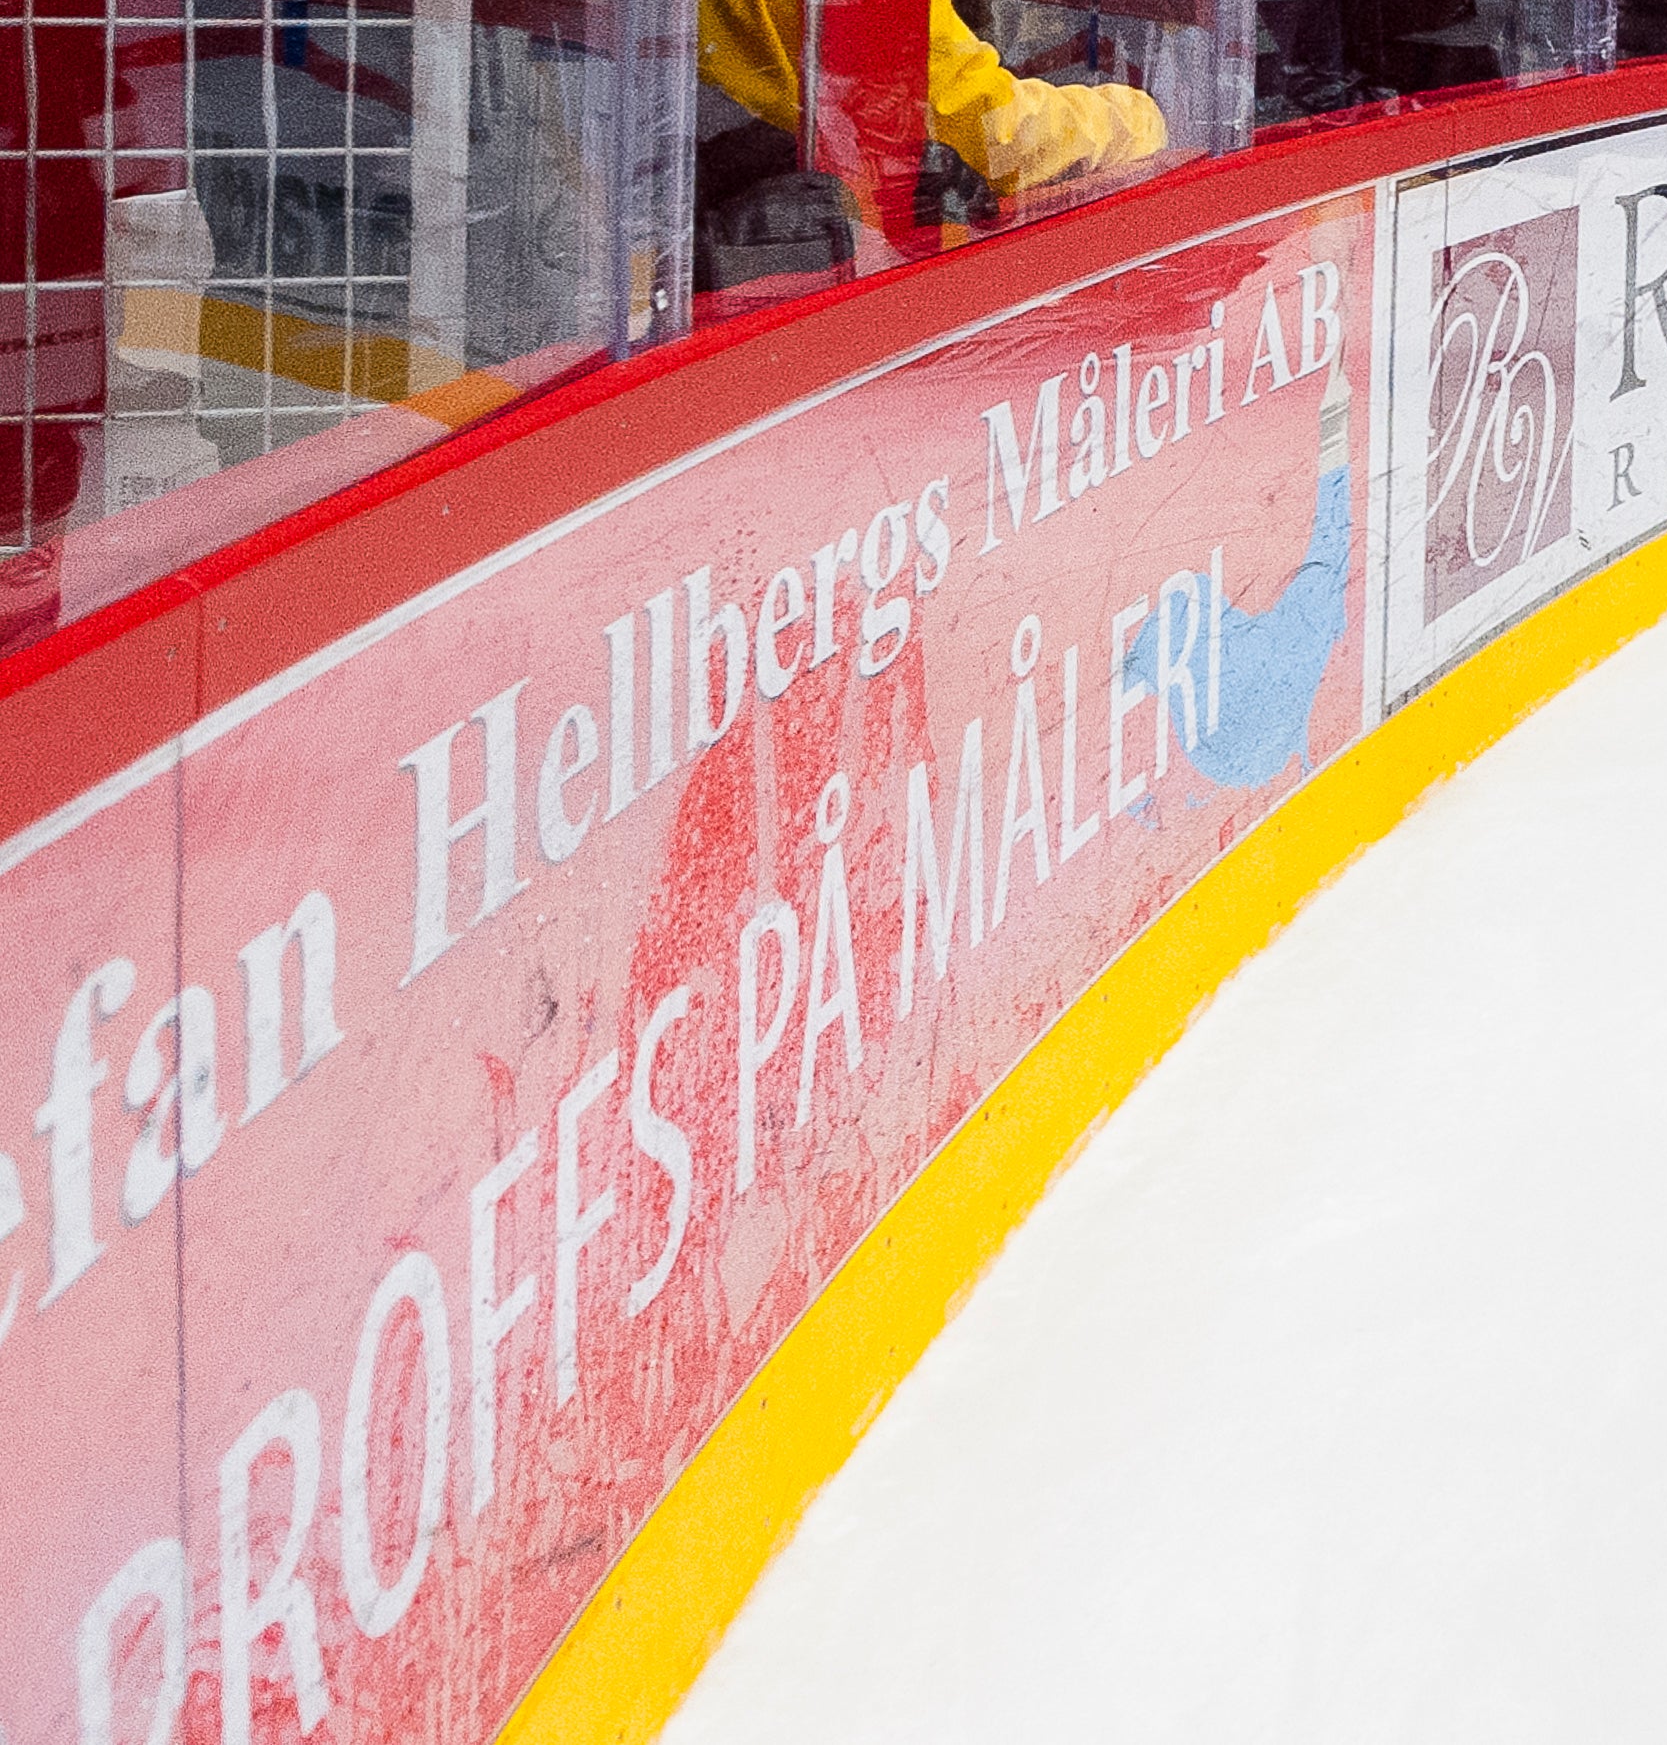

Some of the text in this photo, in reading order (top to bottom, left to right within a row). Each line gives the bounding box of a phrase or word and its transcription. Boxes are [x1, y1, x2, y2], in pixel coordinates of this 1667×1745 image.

[398, 469, 956, 988] Hellbergs
[979, 320, 1229, 559] Måleri
[1241, 259, 1343, 410] AB
[77, 548, 1225, 1745] PROFFS PÅ MÅLERI
